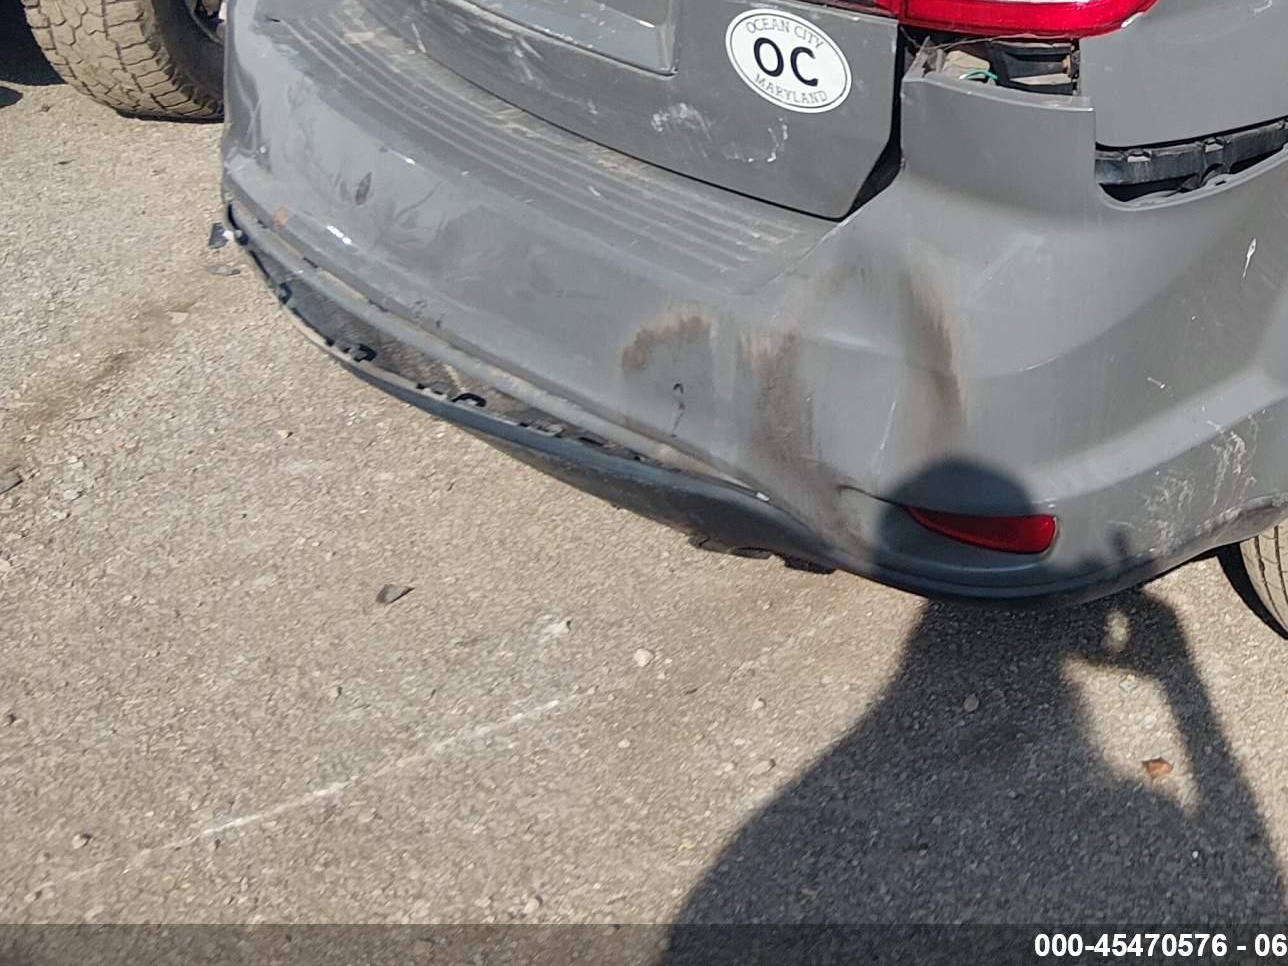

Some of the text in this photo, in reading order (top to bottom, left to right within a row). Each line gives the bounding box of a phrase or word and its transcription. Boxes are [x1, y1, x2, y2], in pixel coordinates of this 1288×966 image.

[745, 17, 825, 49] OCEAN CITY
[753, 36, 819, 87] OC
[754, 72, 829, 105] MARYLAND
